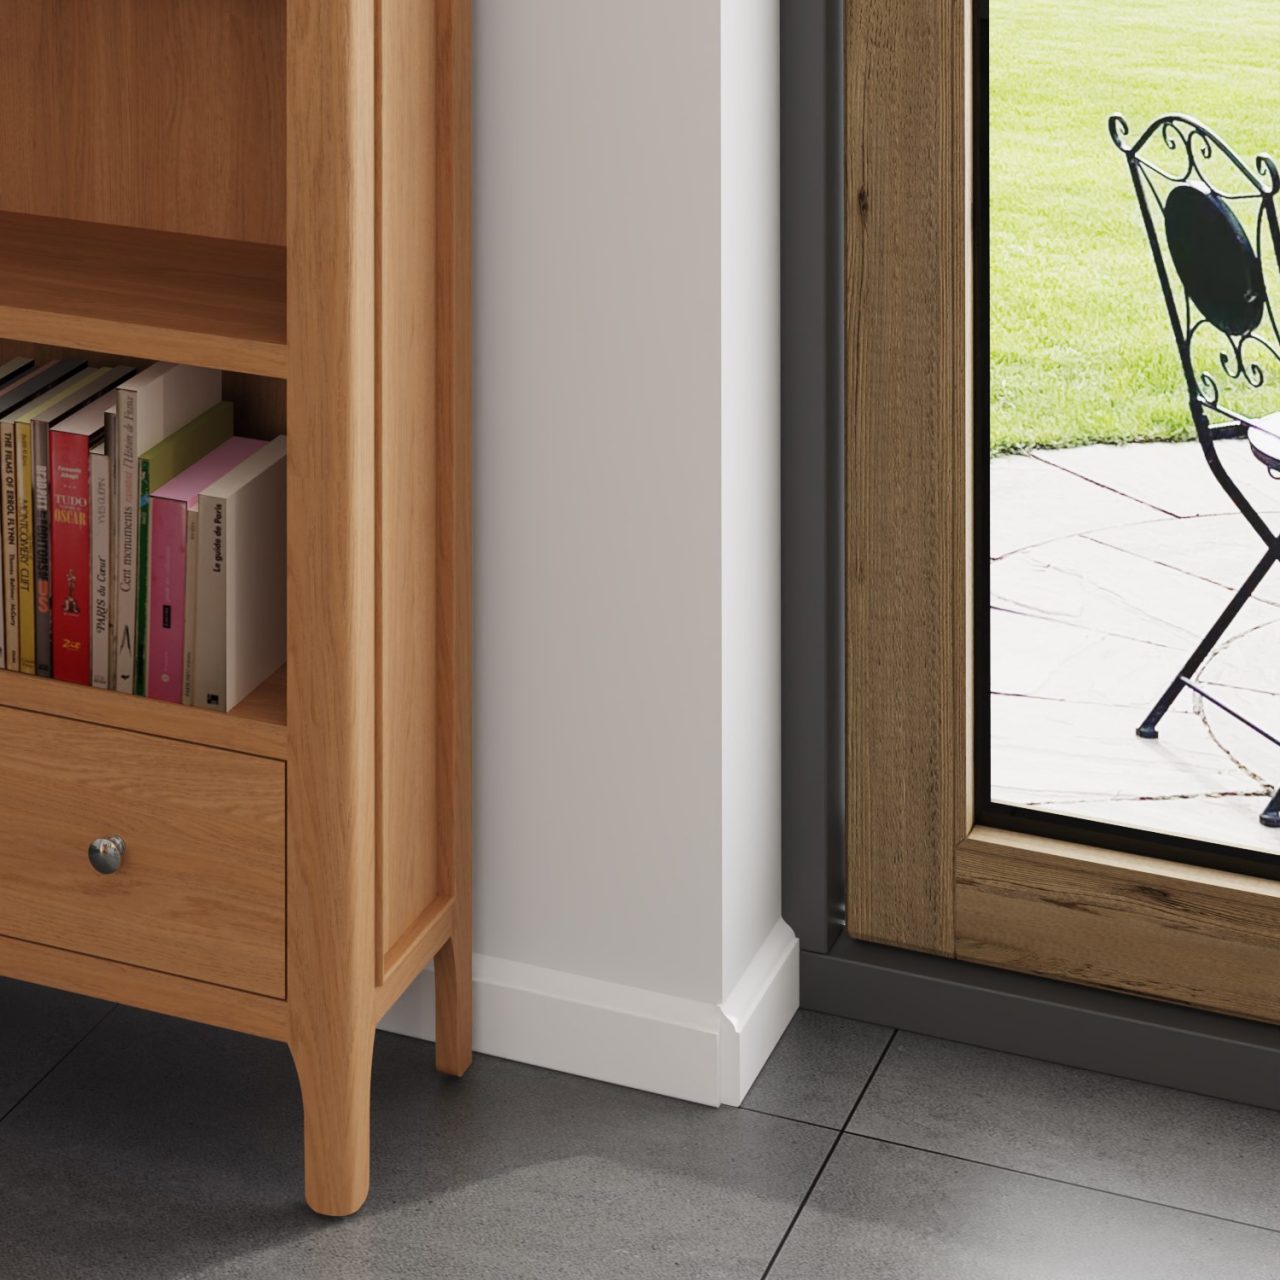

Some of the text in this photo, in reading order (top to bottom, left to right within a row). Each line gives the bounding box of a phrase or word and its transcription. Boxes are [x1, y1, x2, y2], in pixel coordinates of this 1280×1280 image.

[4, 432, 16, 545] THE FILMS OF ERROL FLYNN
[54, 494, 88, 507] TUDO
[54, 508, 88, 526] OSCAR
[121, 506, 133, 565] monuments
[213, 504, 223, 573] Le guide de Paris
[20, 568, 30, 591] CLIFT
[96, 585, 106, 596] du
[119, 569, 132, 592] Cent
[96, 599, 108, 633] PARIS
